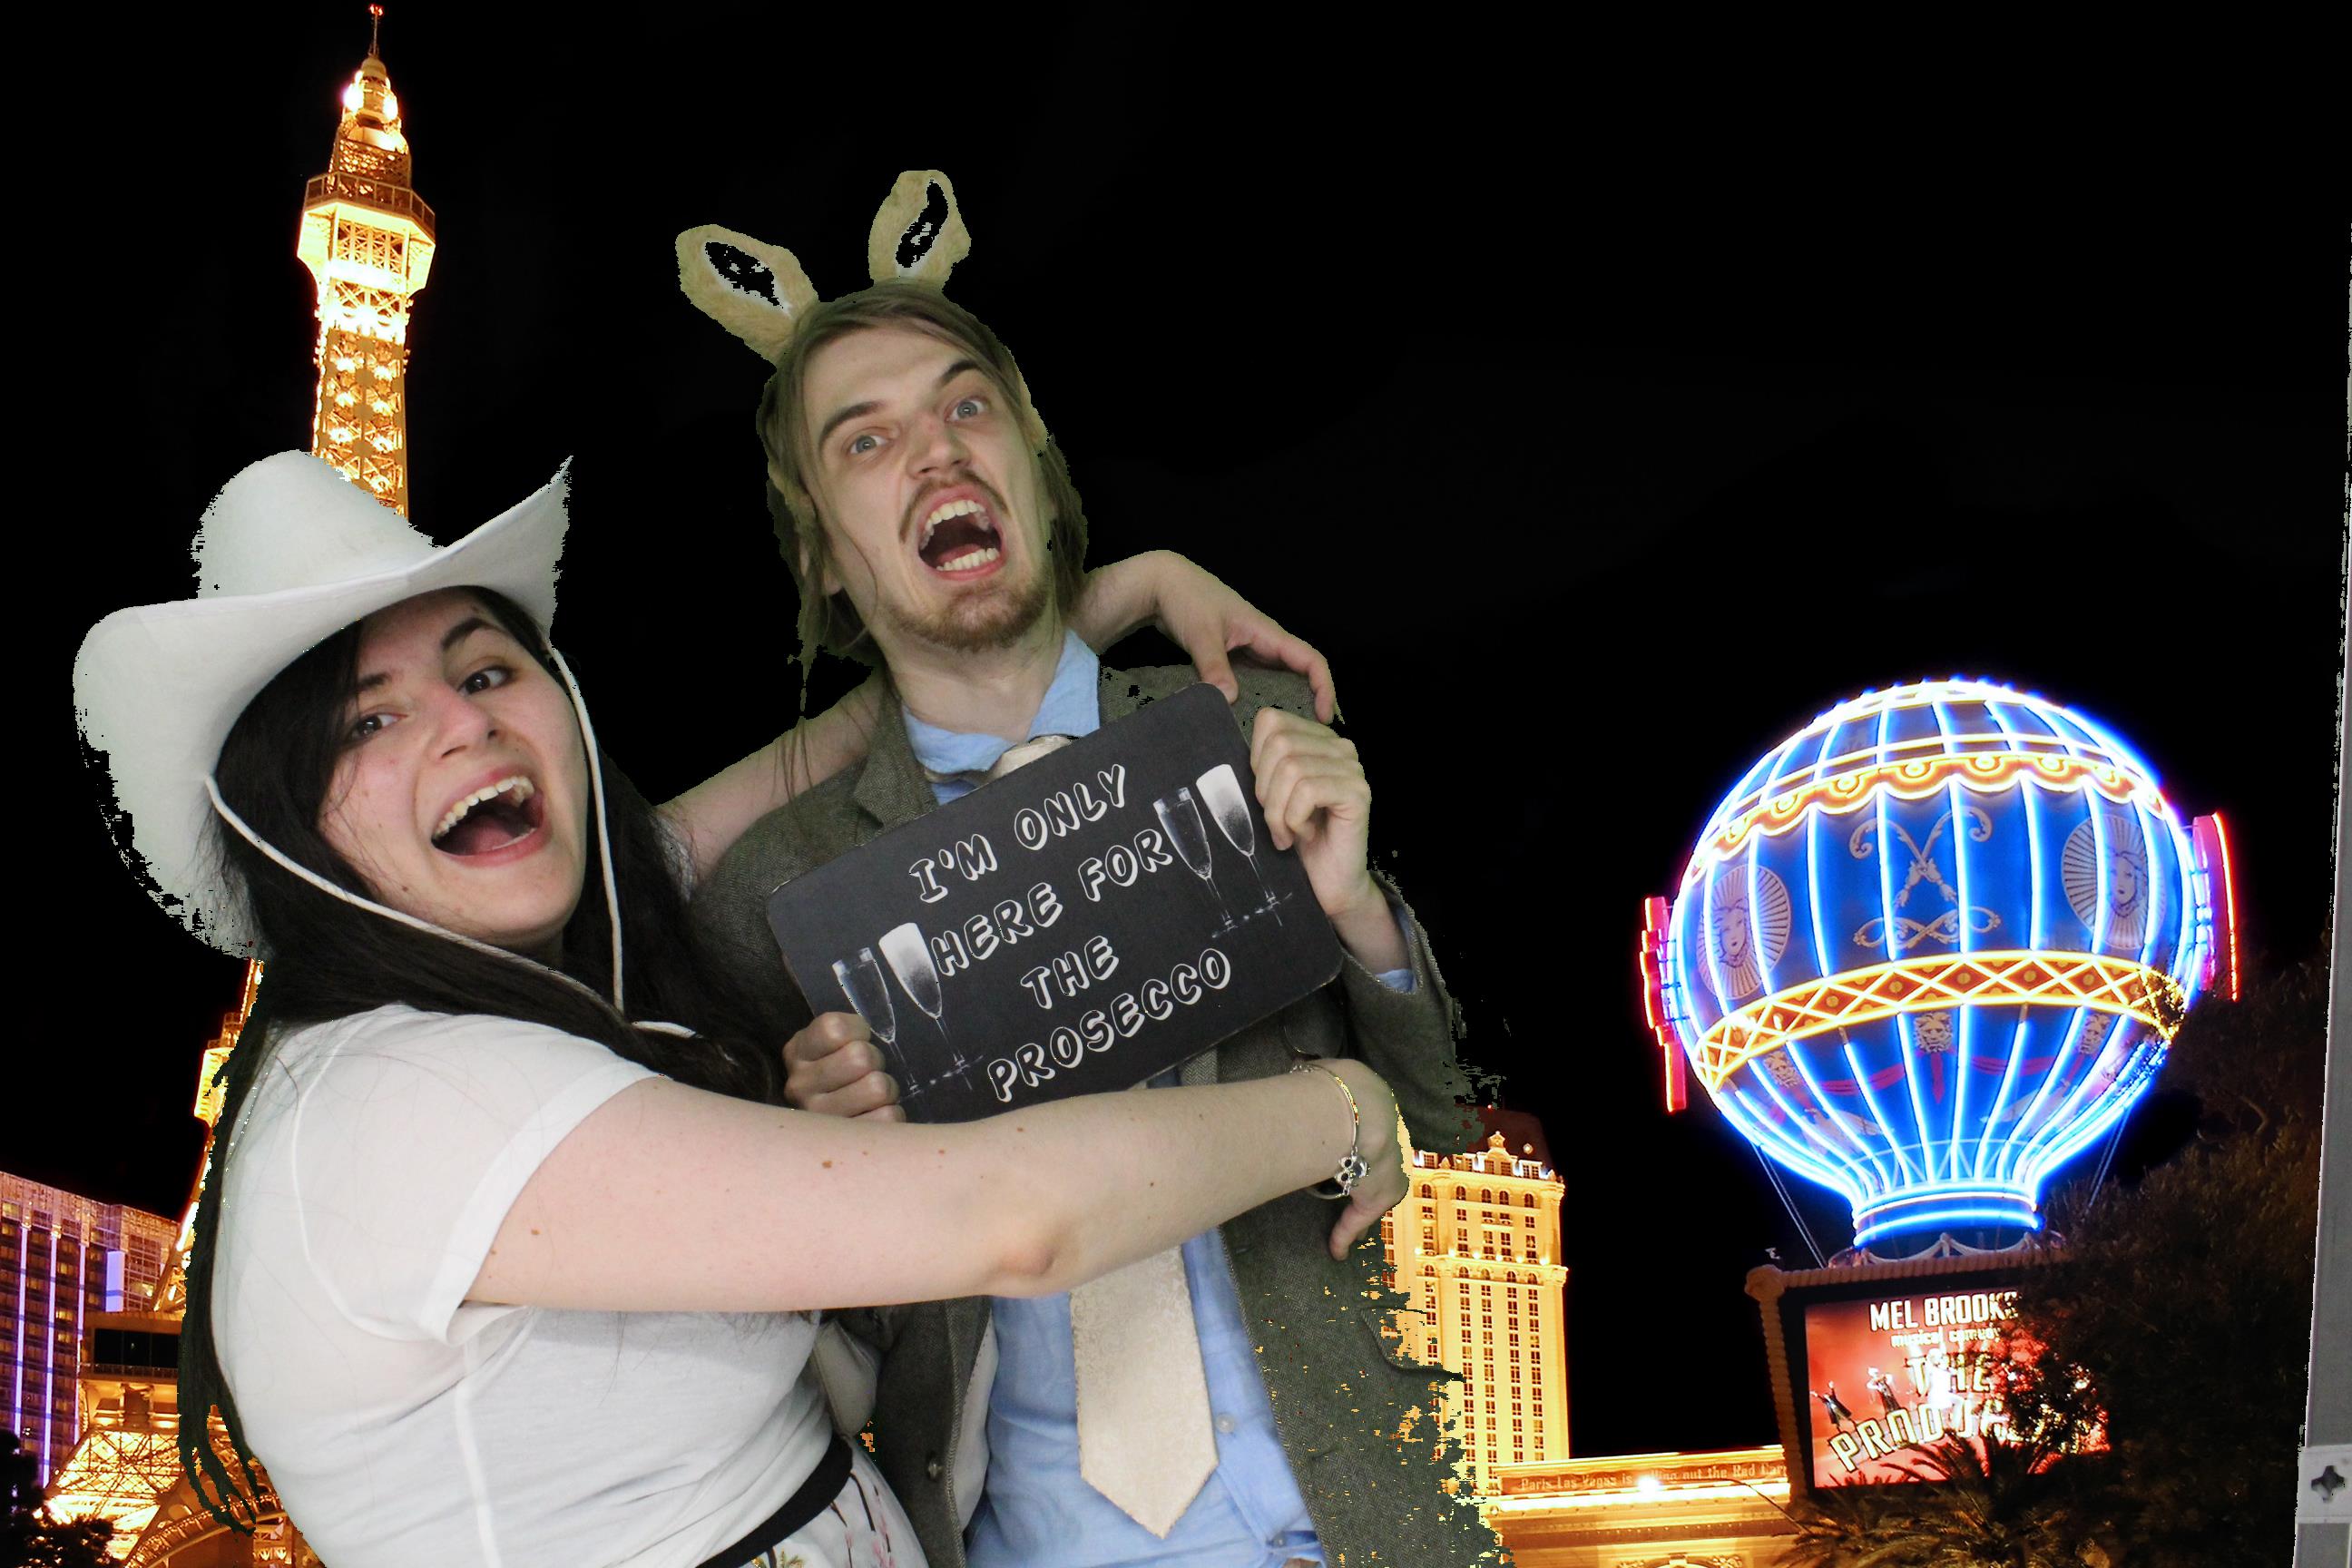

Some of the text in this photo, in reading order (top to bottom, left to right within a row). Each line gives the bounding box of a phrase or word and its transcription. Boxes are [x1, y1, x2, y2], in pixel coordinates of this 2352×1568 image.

[908, 763, 1126, 904] I'M ONLY
[930, 828, 1174, 977] HERE FOR
[986, 947, 1231, 1103] PROSECCO
[1020, 935, 1121, 1010] THE
[1869, 1299, 1919, 1332] MEL
[1520, 1477, 1553, 1492] Paris
[1556, 1475, 1578, 1489] Las
[1582, 1473, 1617, 1489] Vegas
[1622, 1472, 1633, 1485] is
[1681, 1467, 1703, 1481] out
[1707, 1465, 1728, 1479] the
[1731, 1464, 1756, 1478] Red
